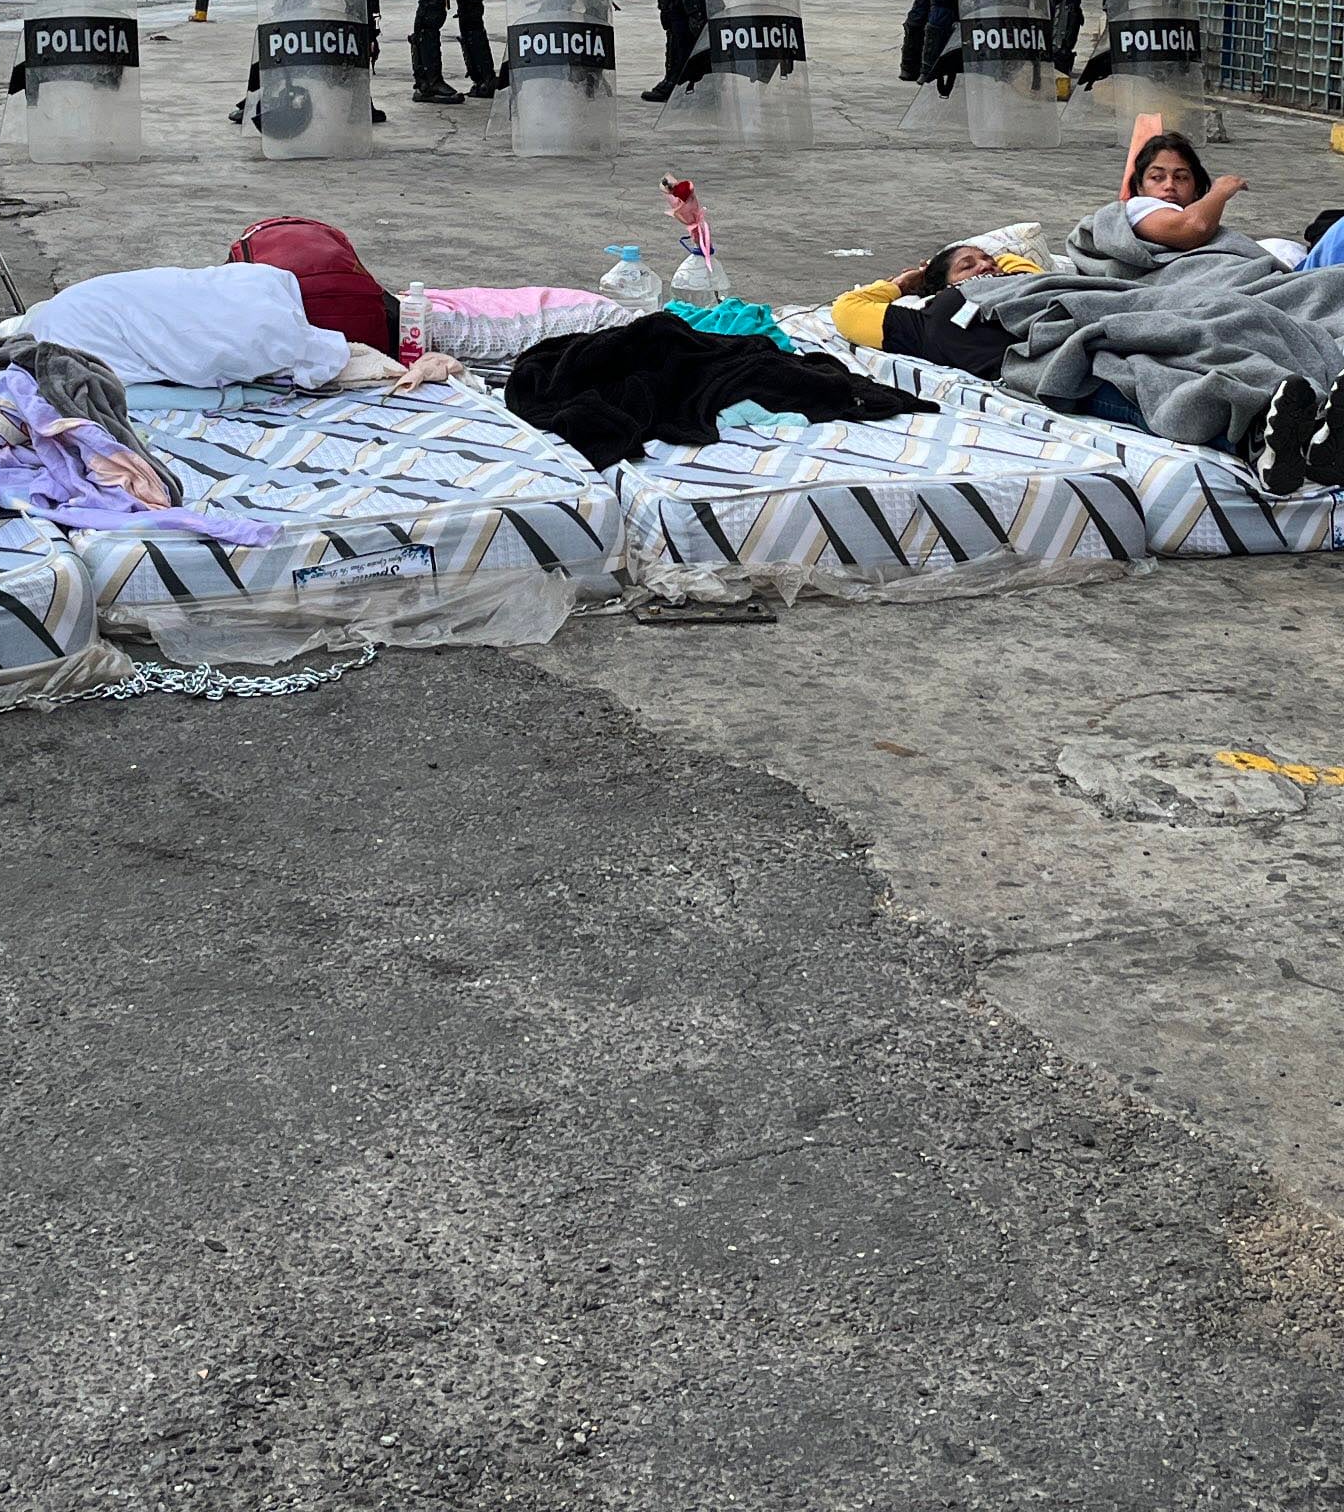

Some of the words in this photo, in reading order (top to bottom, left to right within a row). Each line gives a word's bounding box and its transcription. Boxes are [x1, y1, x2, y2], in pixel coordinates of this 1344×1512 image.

[36, 26, 129, 54] POLICÍA
[269, 28, 359, 57] POLICÍA
[519, 30, 605, 56] POLICÍA
[720, 24, 798, 50] POLICÍA
[972, 25, 1046, 50] POLICÍA
[1120, 27, 1195, 52] POLICÍA
